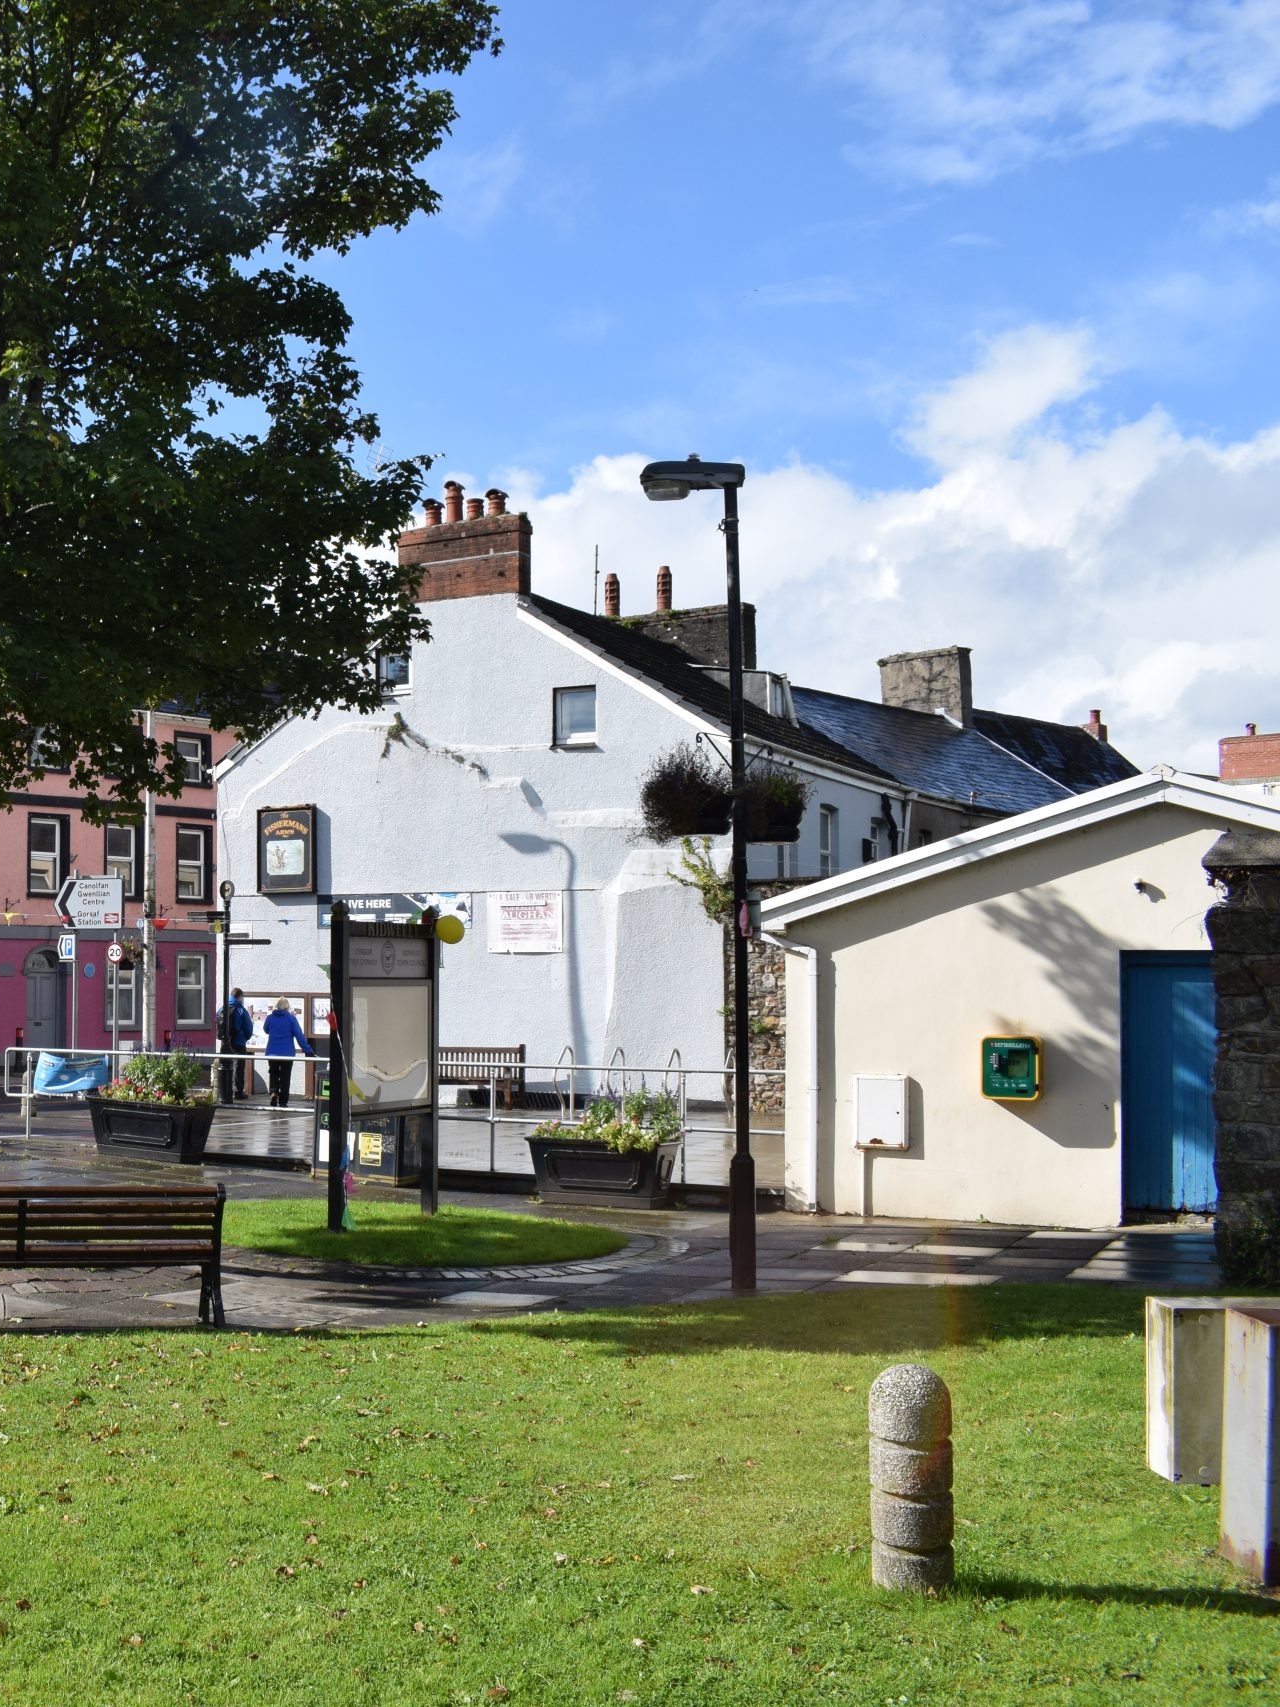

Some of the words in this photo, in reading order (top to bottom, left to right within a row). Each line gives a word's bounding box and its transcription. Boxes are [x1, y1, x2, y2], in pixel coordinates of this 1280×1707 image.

[264, 819, 309, 836] FISHERMANS
[78, 882, 109, 890] Canolfan
[77, 890, 111, 898] Gwenllian
[82, 898, 105, 906] Centre
[342, 899, 364, 909] IVE
[365, 899, 392, 908] HERE
[77, 910, 100, 918] Gorsaf
[502, 910, 555, 920] AUGHAN
[77, 918, 102, 926] Station
[65, 939, 72, 955] P
[109, 948, 121, 957] 20
